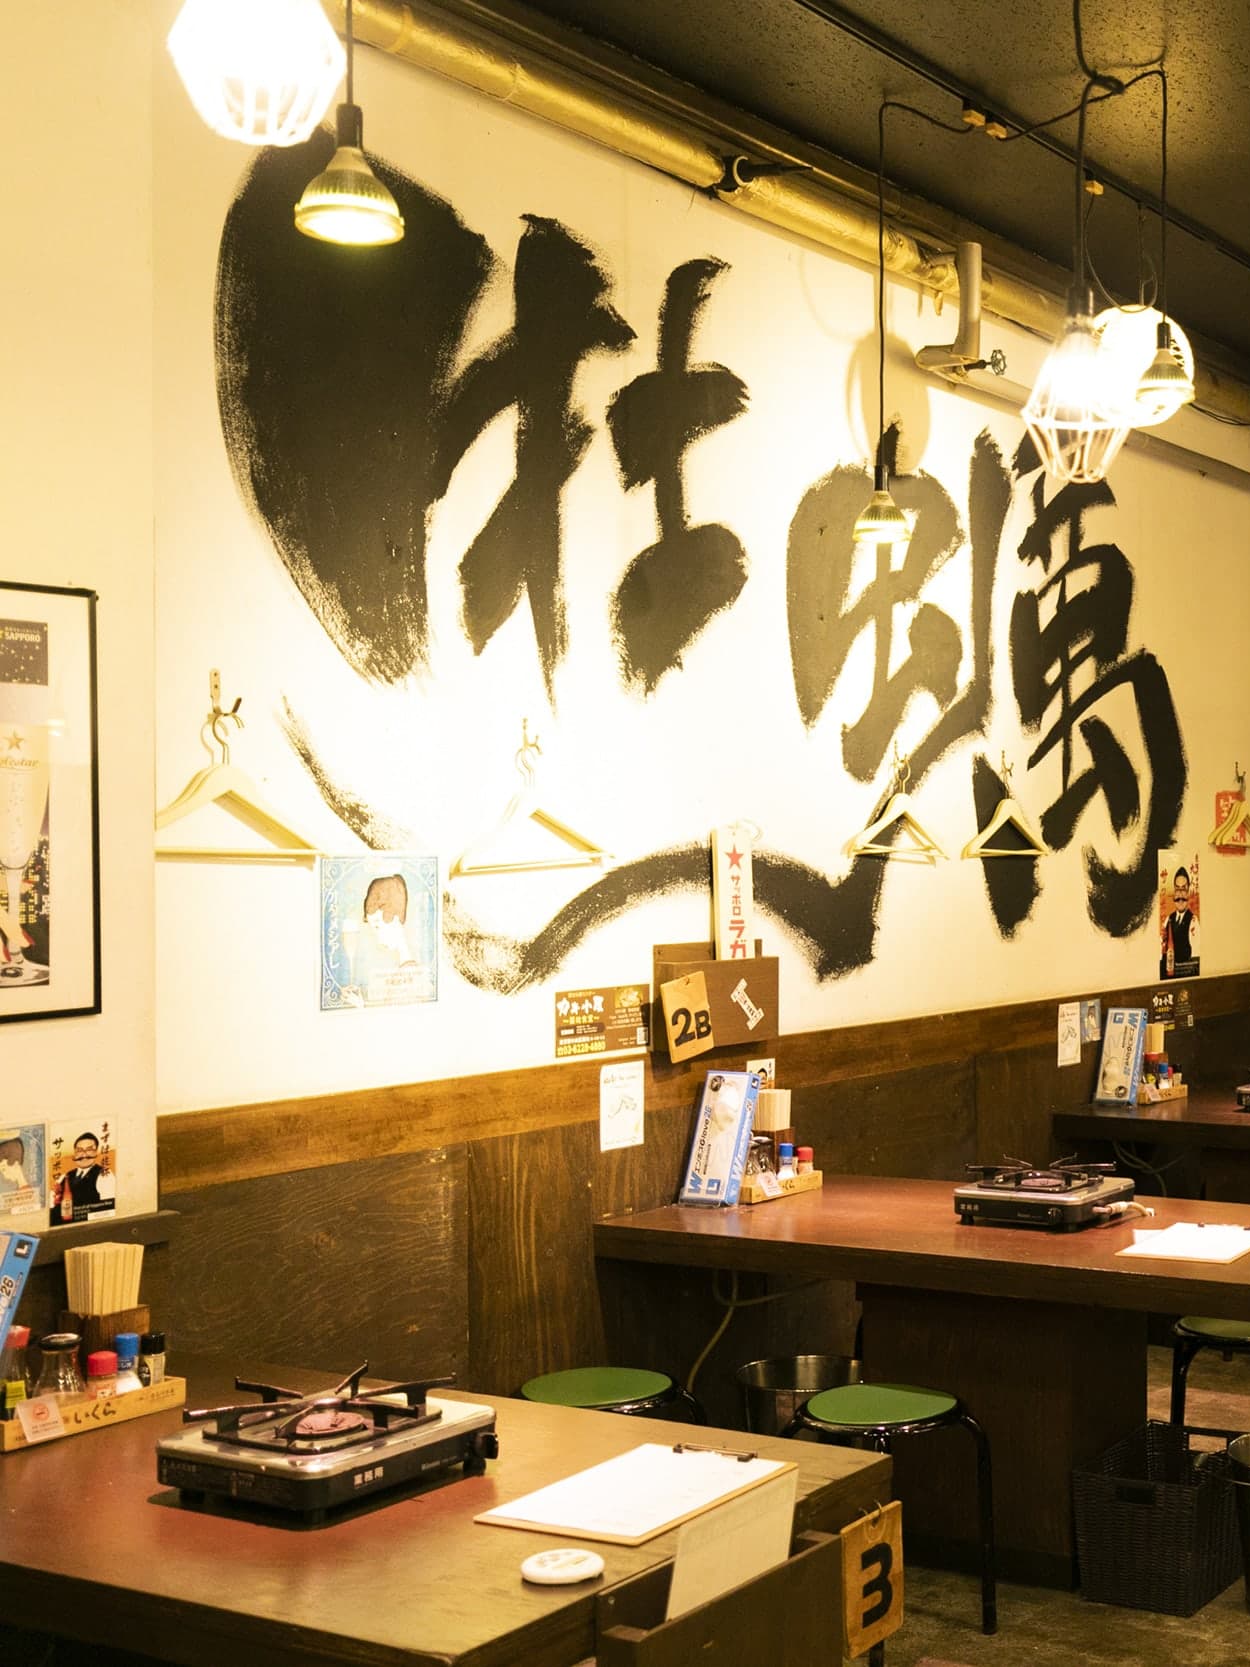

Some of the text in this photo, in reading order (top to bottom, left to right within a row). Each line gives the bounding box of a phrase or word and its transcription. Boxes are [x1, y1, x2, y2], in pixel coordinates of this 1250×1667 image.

[5, 631, 41, 643] SAPPORO
[671, 1007, 712, 1048] 2B
[859, 1540, 894, 1630] 3
